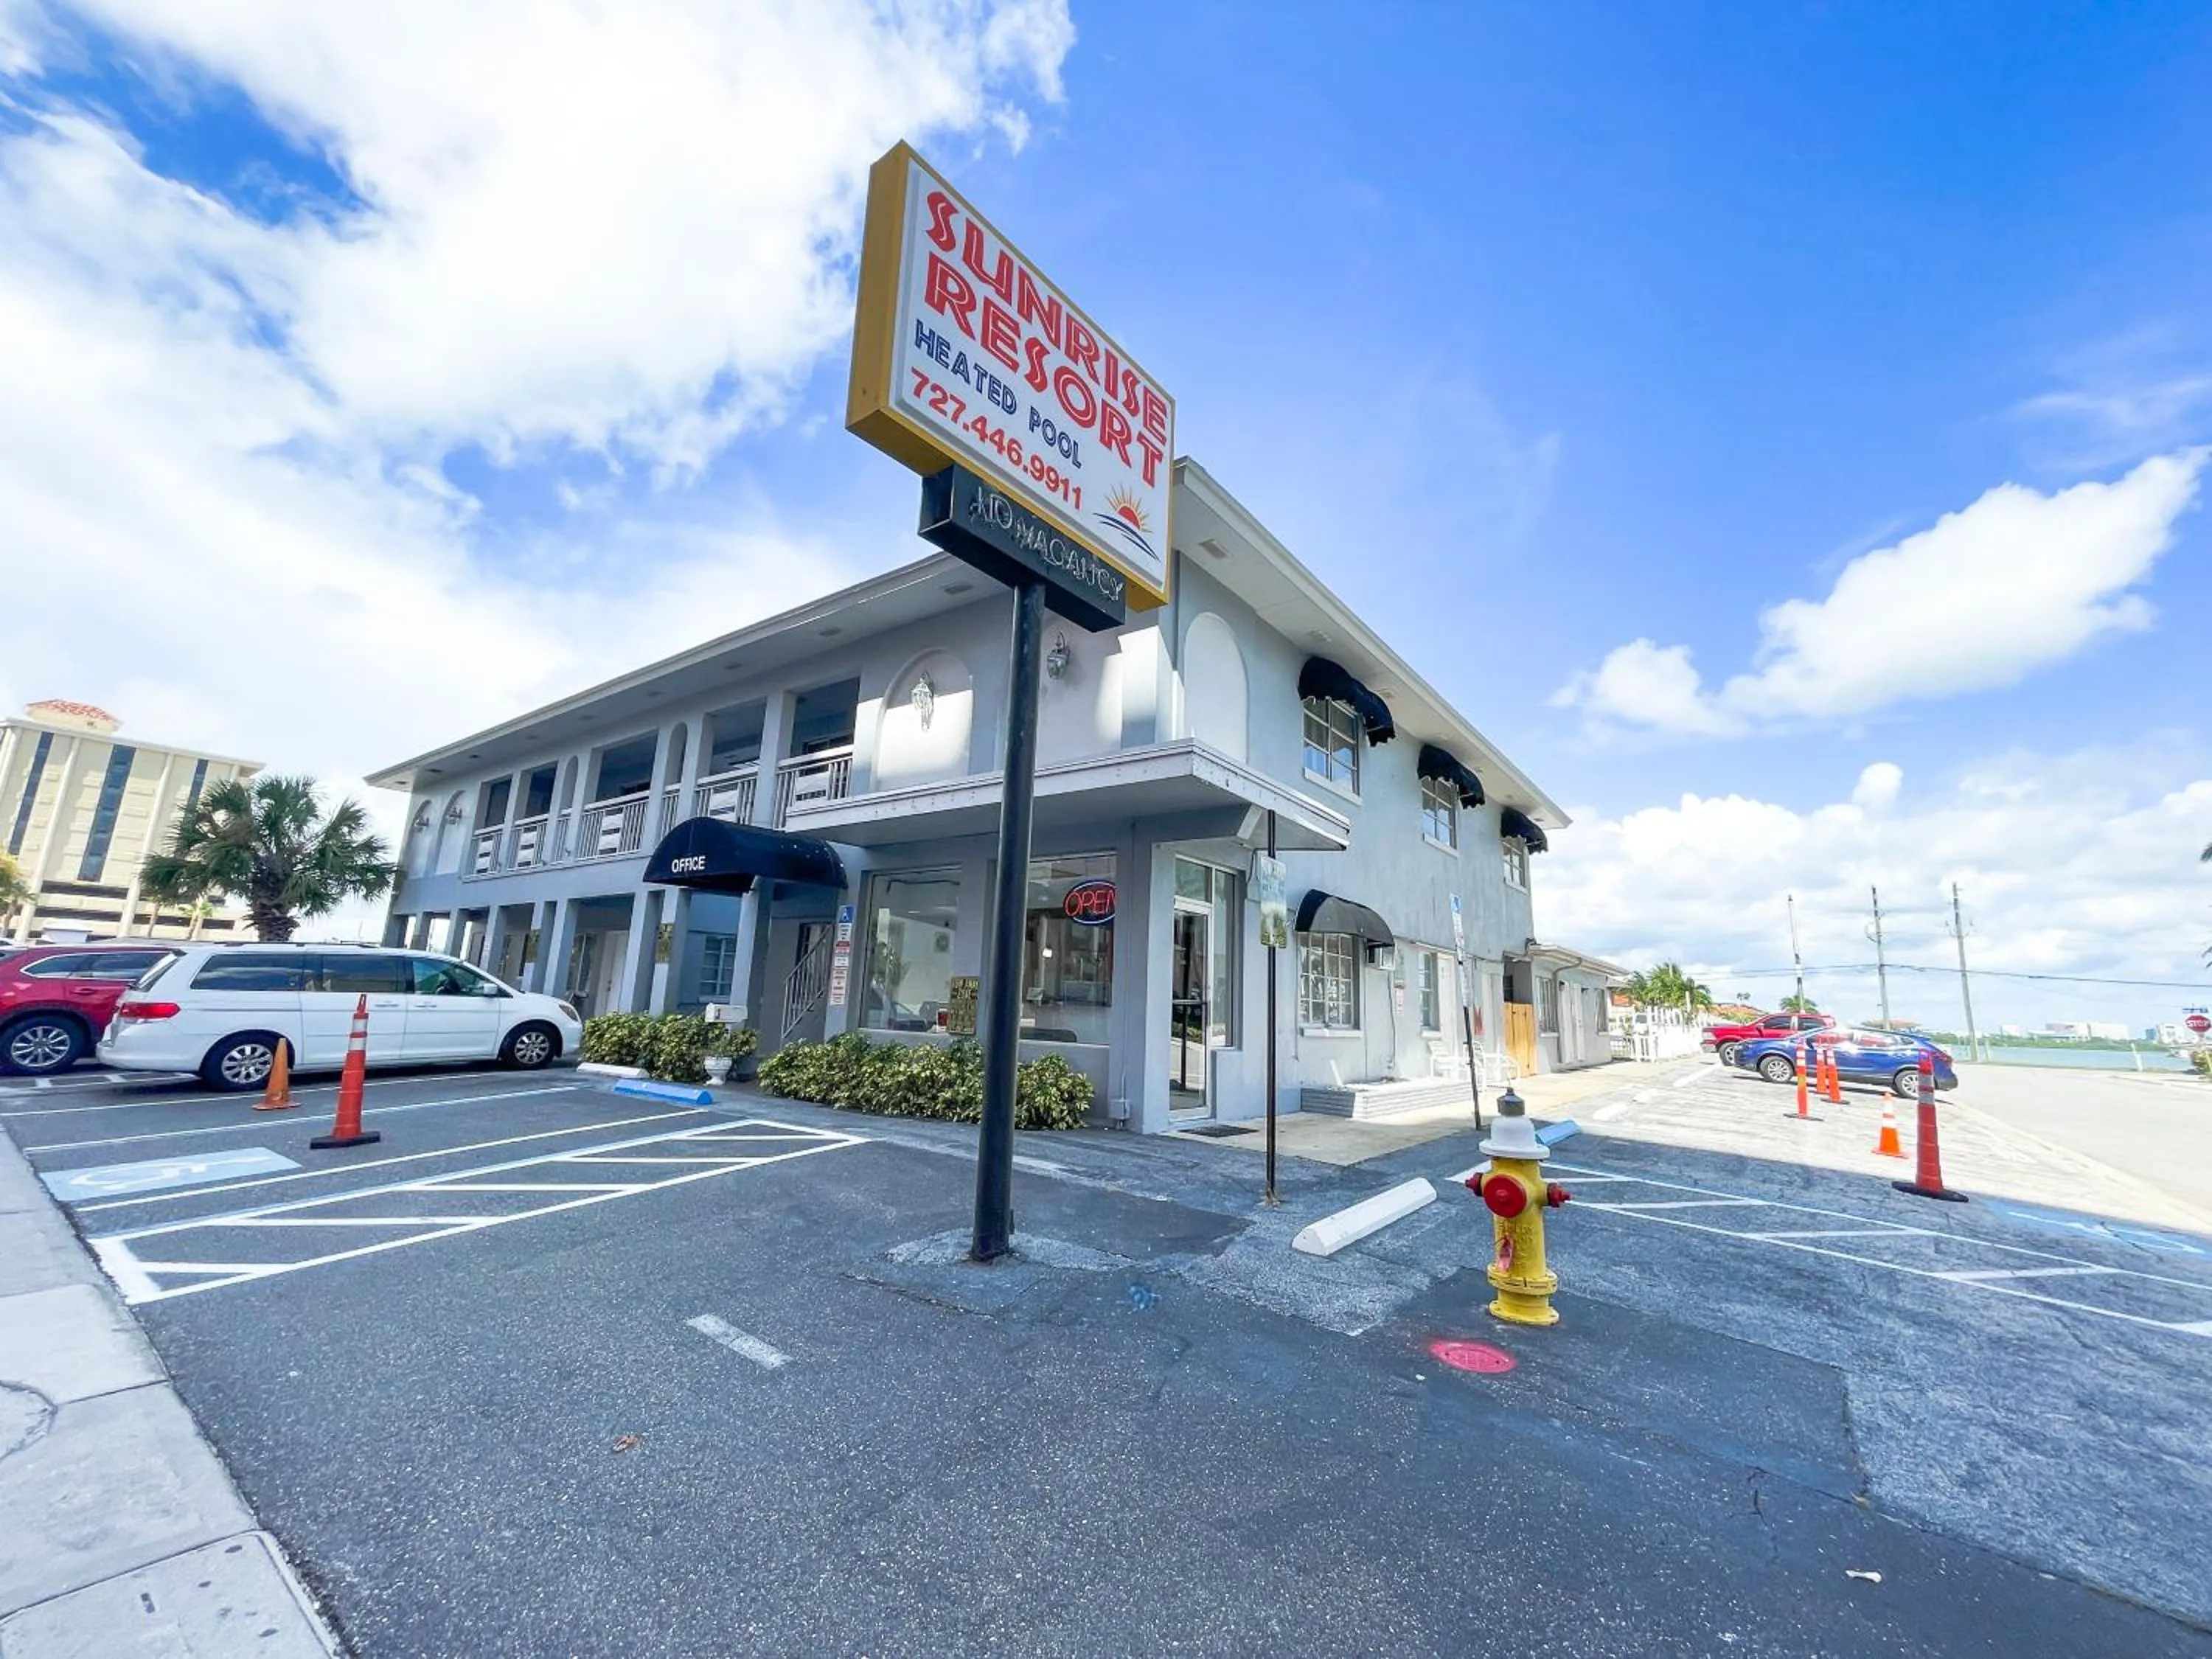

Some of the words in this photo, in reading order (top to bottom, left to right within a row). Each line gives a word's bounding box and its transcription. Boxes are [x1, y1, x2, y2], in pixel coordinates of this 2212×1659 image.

[915, 319, 1017, 415] HEATED
[1029, 405, 1082, 469] POOL
[925, 251, 1163, 489] RESORT
[926, 192, 1167, 447] SUNRISE
[911, 366, 1082, 510] 727.446.9911
[672, 855, 706, 873] OFFICE
